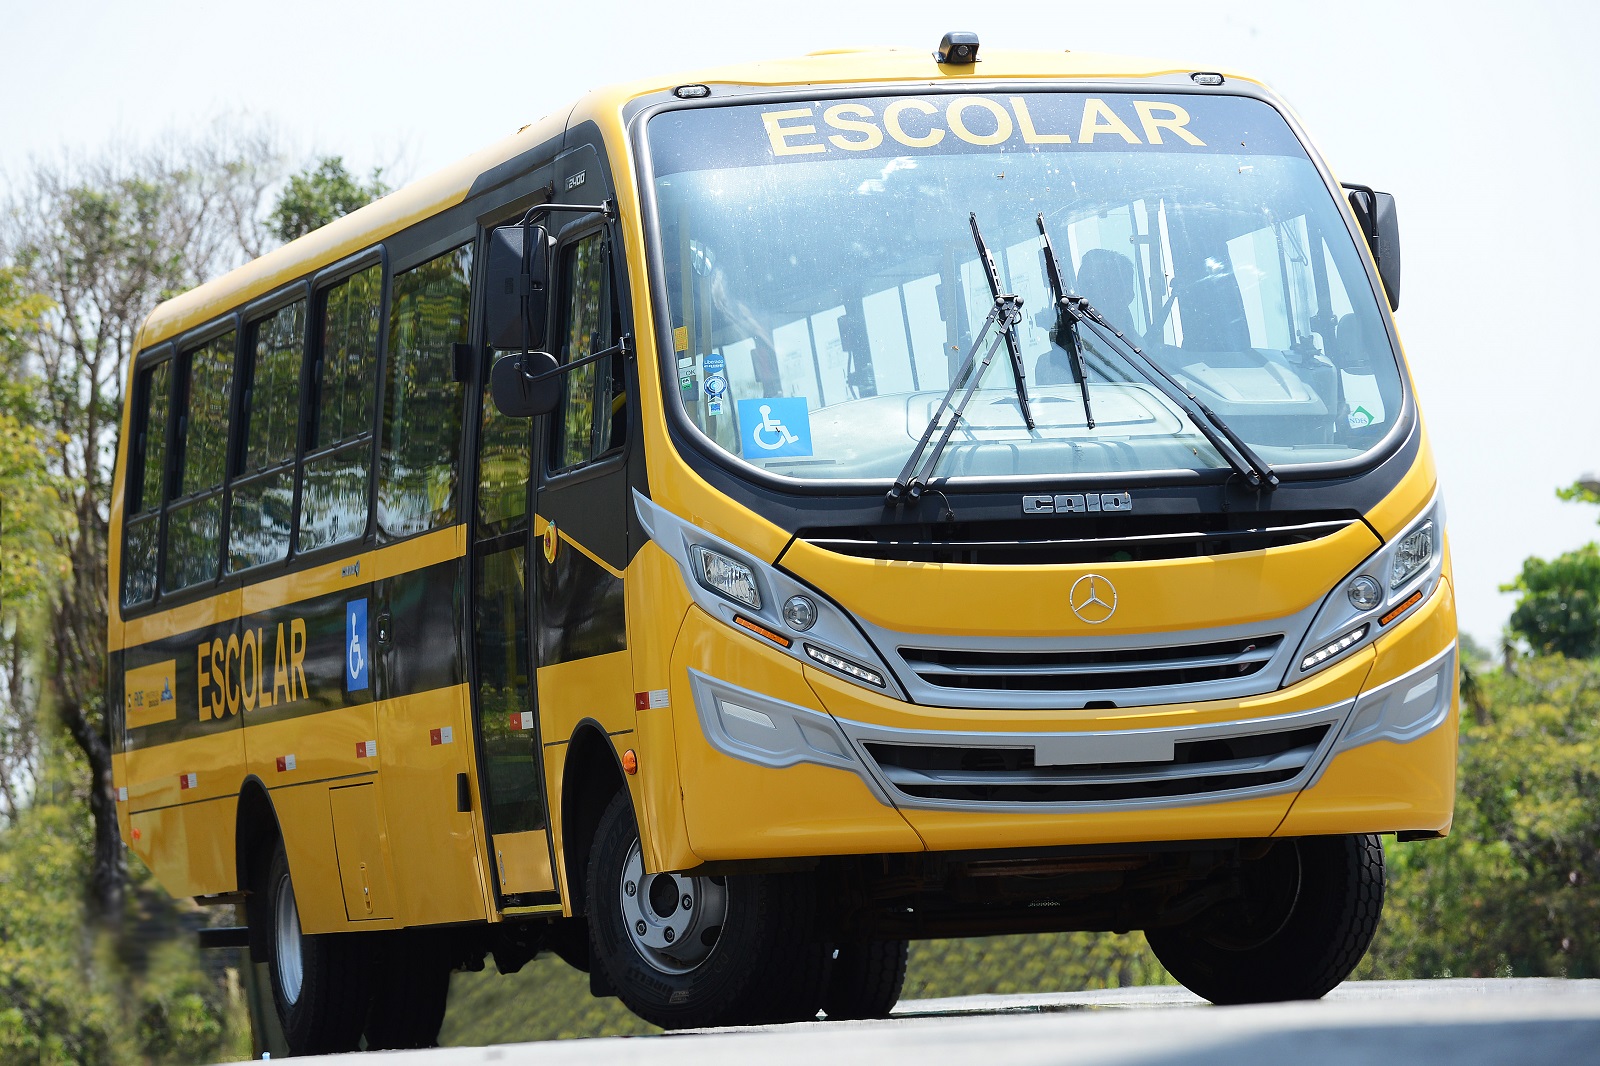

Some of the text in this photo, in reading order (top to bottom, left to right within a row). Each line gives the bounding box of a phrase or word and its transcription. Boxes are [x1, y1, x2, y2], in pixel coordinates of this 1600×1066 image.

[761, 97, 1207, 156] ESCOLAR
[568, 172, 585, 189] 2400
[1023, 494, 1132, 513] CAIO
[198, 618, 309, 721] ESCOLAR
